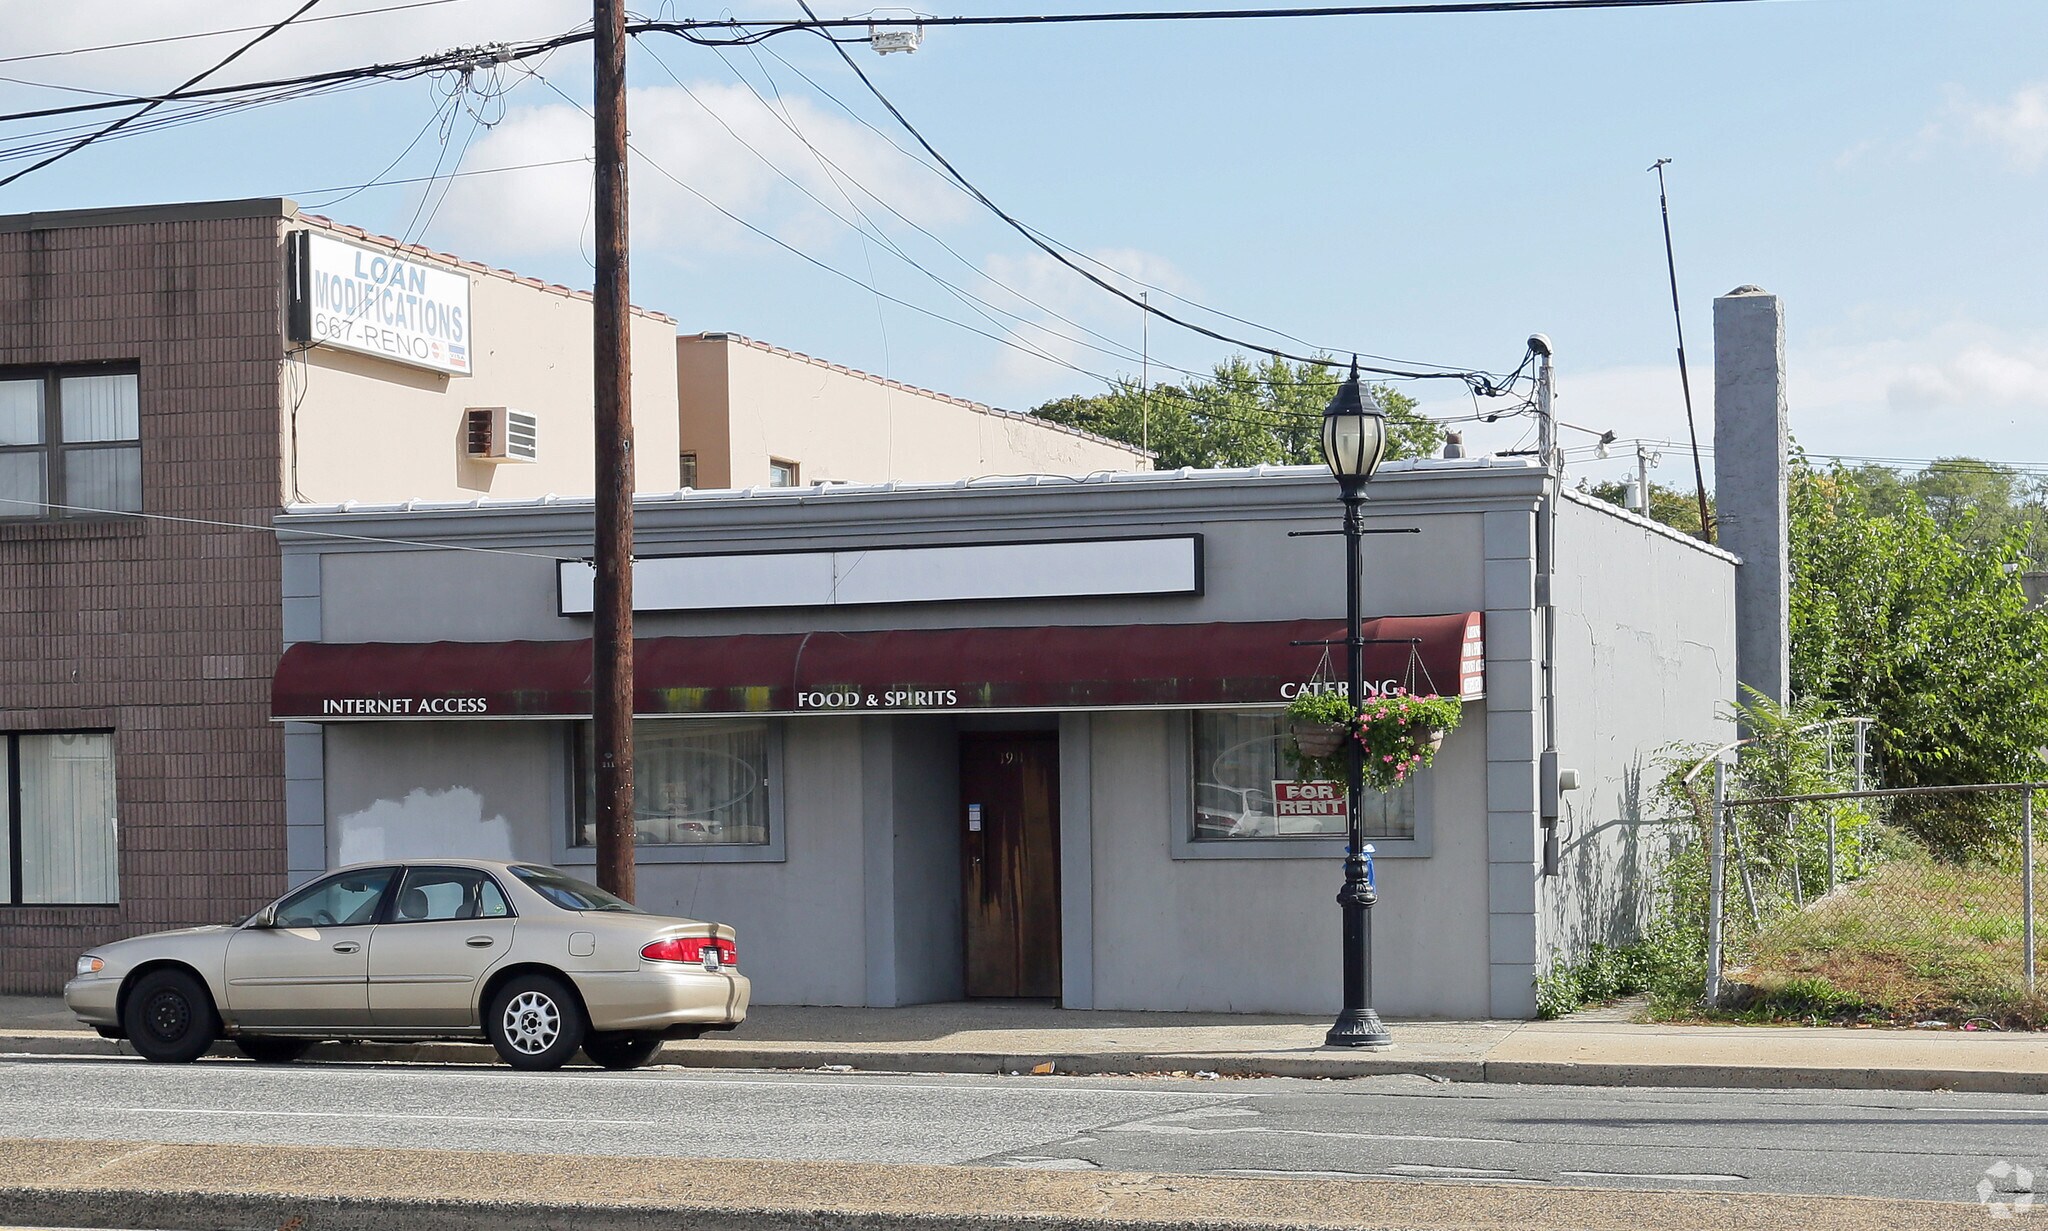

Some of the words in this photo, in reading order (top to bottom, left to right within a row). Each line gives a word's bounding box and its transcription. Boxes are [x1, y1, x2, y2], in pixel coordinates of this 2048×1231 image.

[355, 251, 426, 295] LOAN
[315, 269, 463, 343] MODIFICATIONS
[315, 313, 429, 359] 667-RENO
[1280, 679, 1398, 699] CATERNG
[323, 698, 412, 714] INTERNET
[417, 697, 487, 713] ACCESS
[798, 692, 860, 708] FOOD
[866, 693, 879, 707] &
[884, 690, 957, 707] SPIRITS
[1285, 785, 1334, 799] FOR
[1280, 800, 1343, 814] RENT
